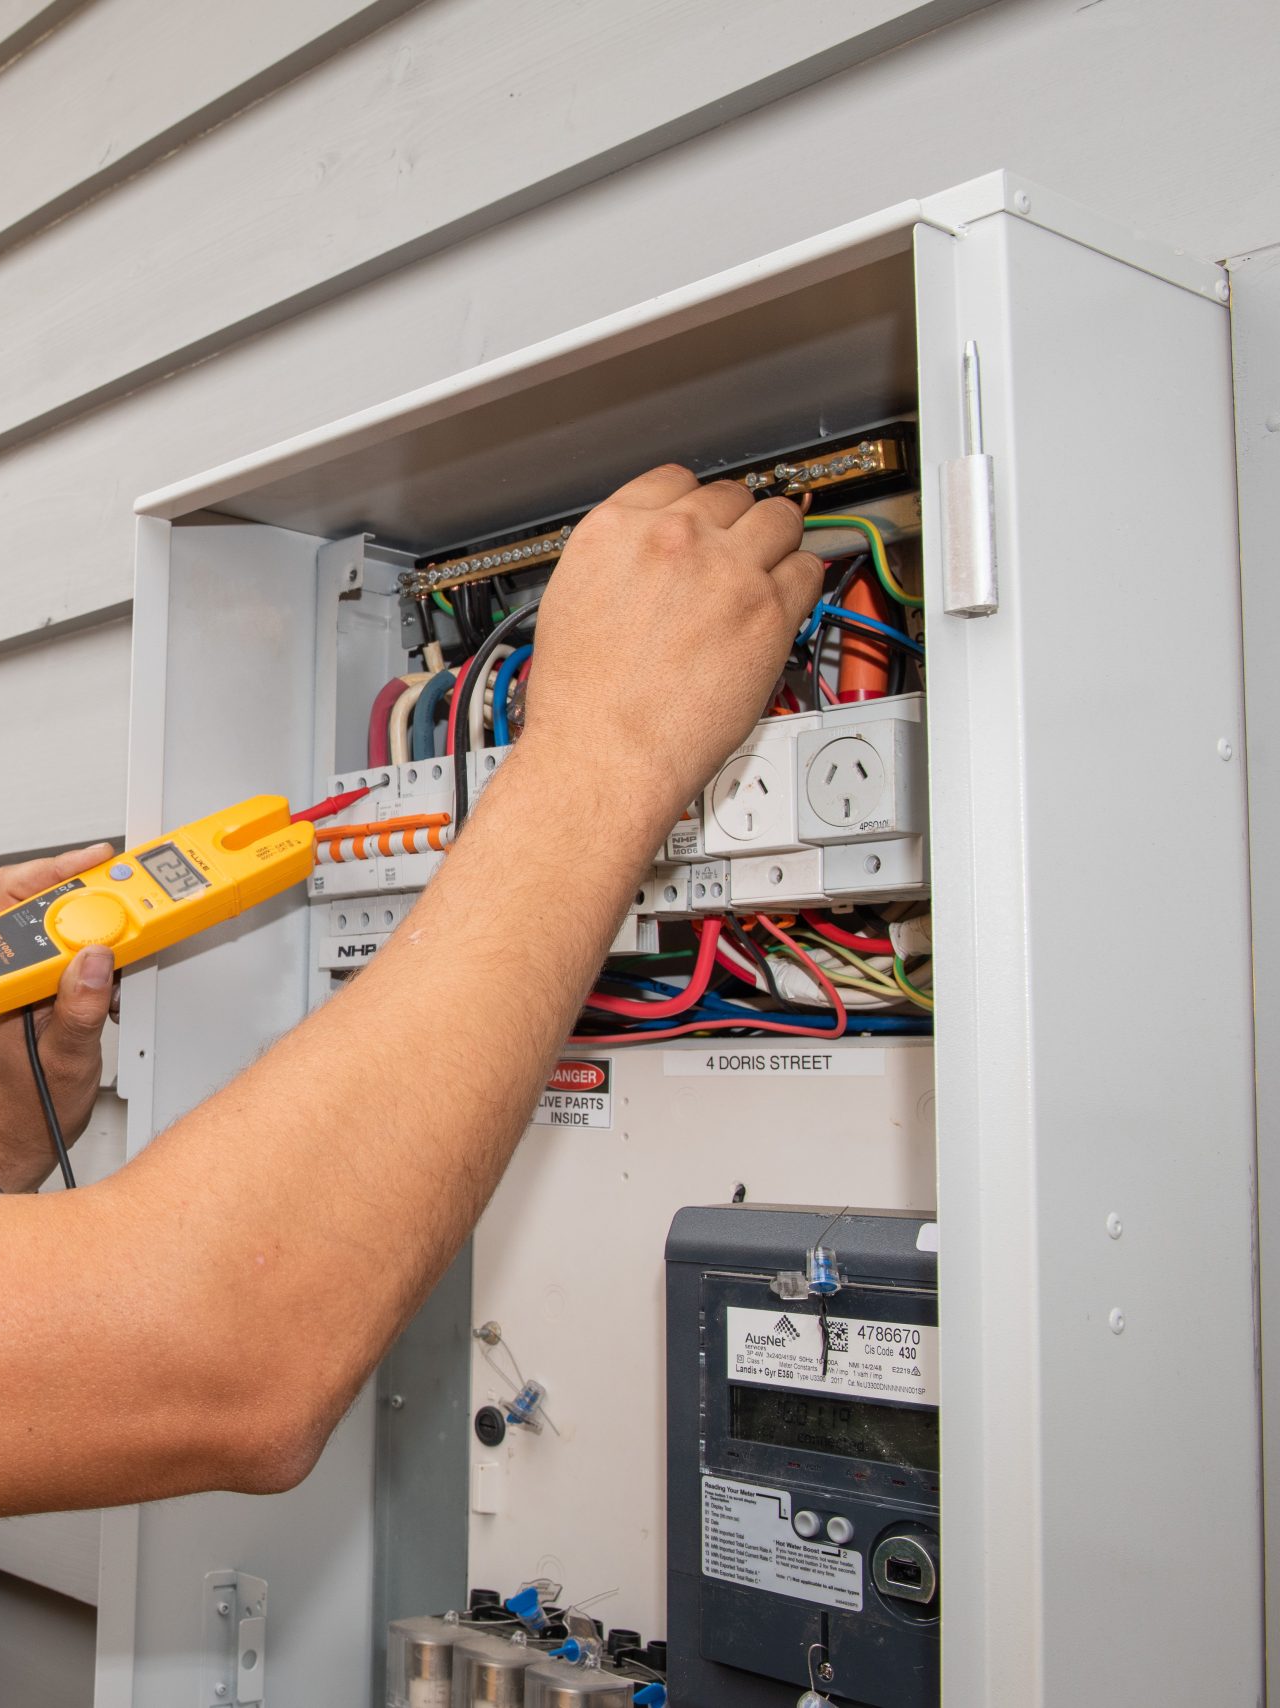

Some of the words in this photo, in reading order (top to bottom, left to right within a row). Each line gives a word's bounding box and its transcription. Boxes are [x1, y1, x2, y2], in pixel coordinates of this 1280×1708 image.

[188, 849, 210, 872] FLUKE
[157, 859, 199, 893] 234
[35, 935, 47, 947] OFF
[338, 944, 376, 958] NHP
[706, 1057, 714, 1070] 4
[720, 1056, 765, 1070] DORIS
[770, 1055, 832, 1070] STREET
[565, 1097, 604, 1110] PARTS
[550, 1112, 589, 1125] INSIDE
[745, 1332, 786, 1347] AusNet
[858, 1325, 920, 1345] 4786670
[865, 1344, 875, 1354] Cis
[877, 1346, 893, 1356] Code
[899, 1347, 916, 1360] 430
[736, 1364, 757, 1374] Landis
[765, 1368, 776, 1378] Gyr
[794, 1363, 818, 1371] Constants
[705, 1482, 725, 1492] Reading
[740, 1489, 755, 1497] Meter
[786, 1542, 801, 1551] Water
[803, 1546, 820, 1554] Boost
[720, 1554, 735, 1562] Exported
[720, 1562, 735, 1570] Exported
[720, 1570, 735, 1578] Exported
